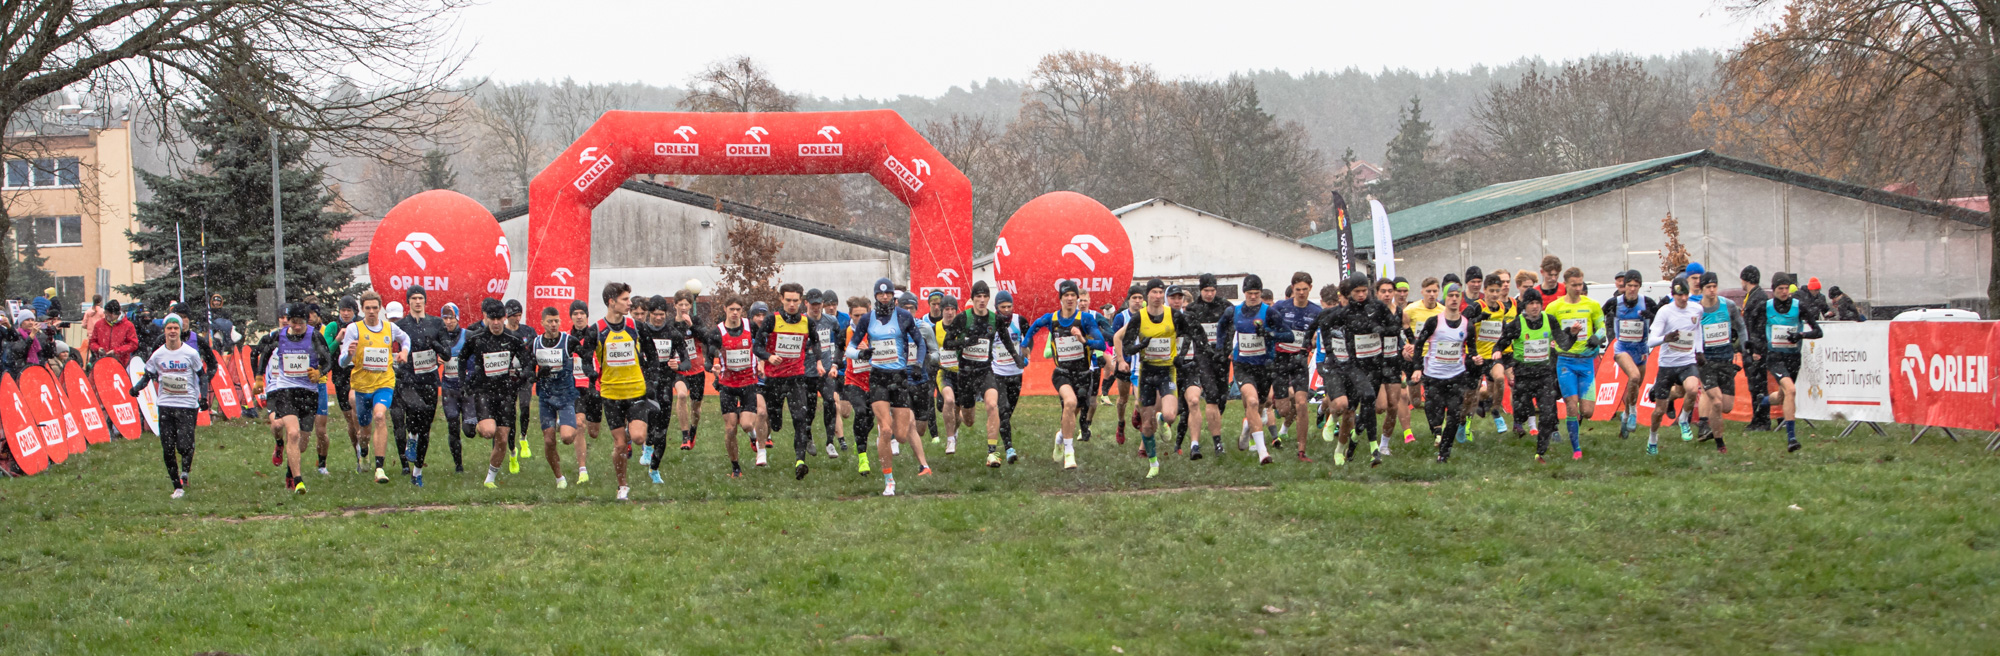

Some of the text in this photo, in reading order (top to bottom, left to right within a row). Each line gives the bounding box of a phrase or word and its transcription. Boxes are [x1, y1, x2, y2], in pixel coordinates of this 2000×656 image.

[657, 145, 696, 154] ORLEN
[729, 146, 767, 154] ORLEN
[801, 146, 839, 154] ORLEN
[578, 158, 610, 187] ORLEN
[888, 160, 919, 189] ORLEN
[390, 275, 448, 291] ORLEN
[536, 287, 572, 297] ORLEN
[922, 289, 958, 298] OEN
[1706, 331, 1727, 339] LISIECKI
[1825, 347, 1867, 362] Ministerstwo
[169, 361, 174, 369] 5
[1929, 353, 1988, 393] ORLEN
[1826, 369, 1845, 388] Sportu
[1851, 369, 1881, 388] Turystyki
[1599, 386, 1617, 402] ORLEN
[84, 411, 100, 427] ORLEN
[116, 406, 134, 422] ORLEN
[43, 423, 61, 442] ORLEN
[19, 431, 39, 452] ORLEN
